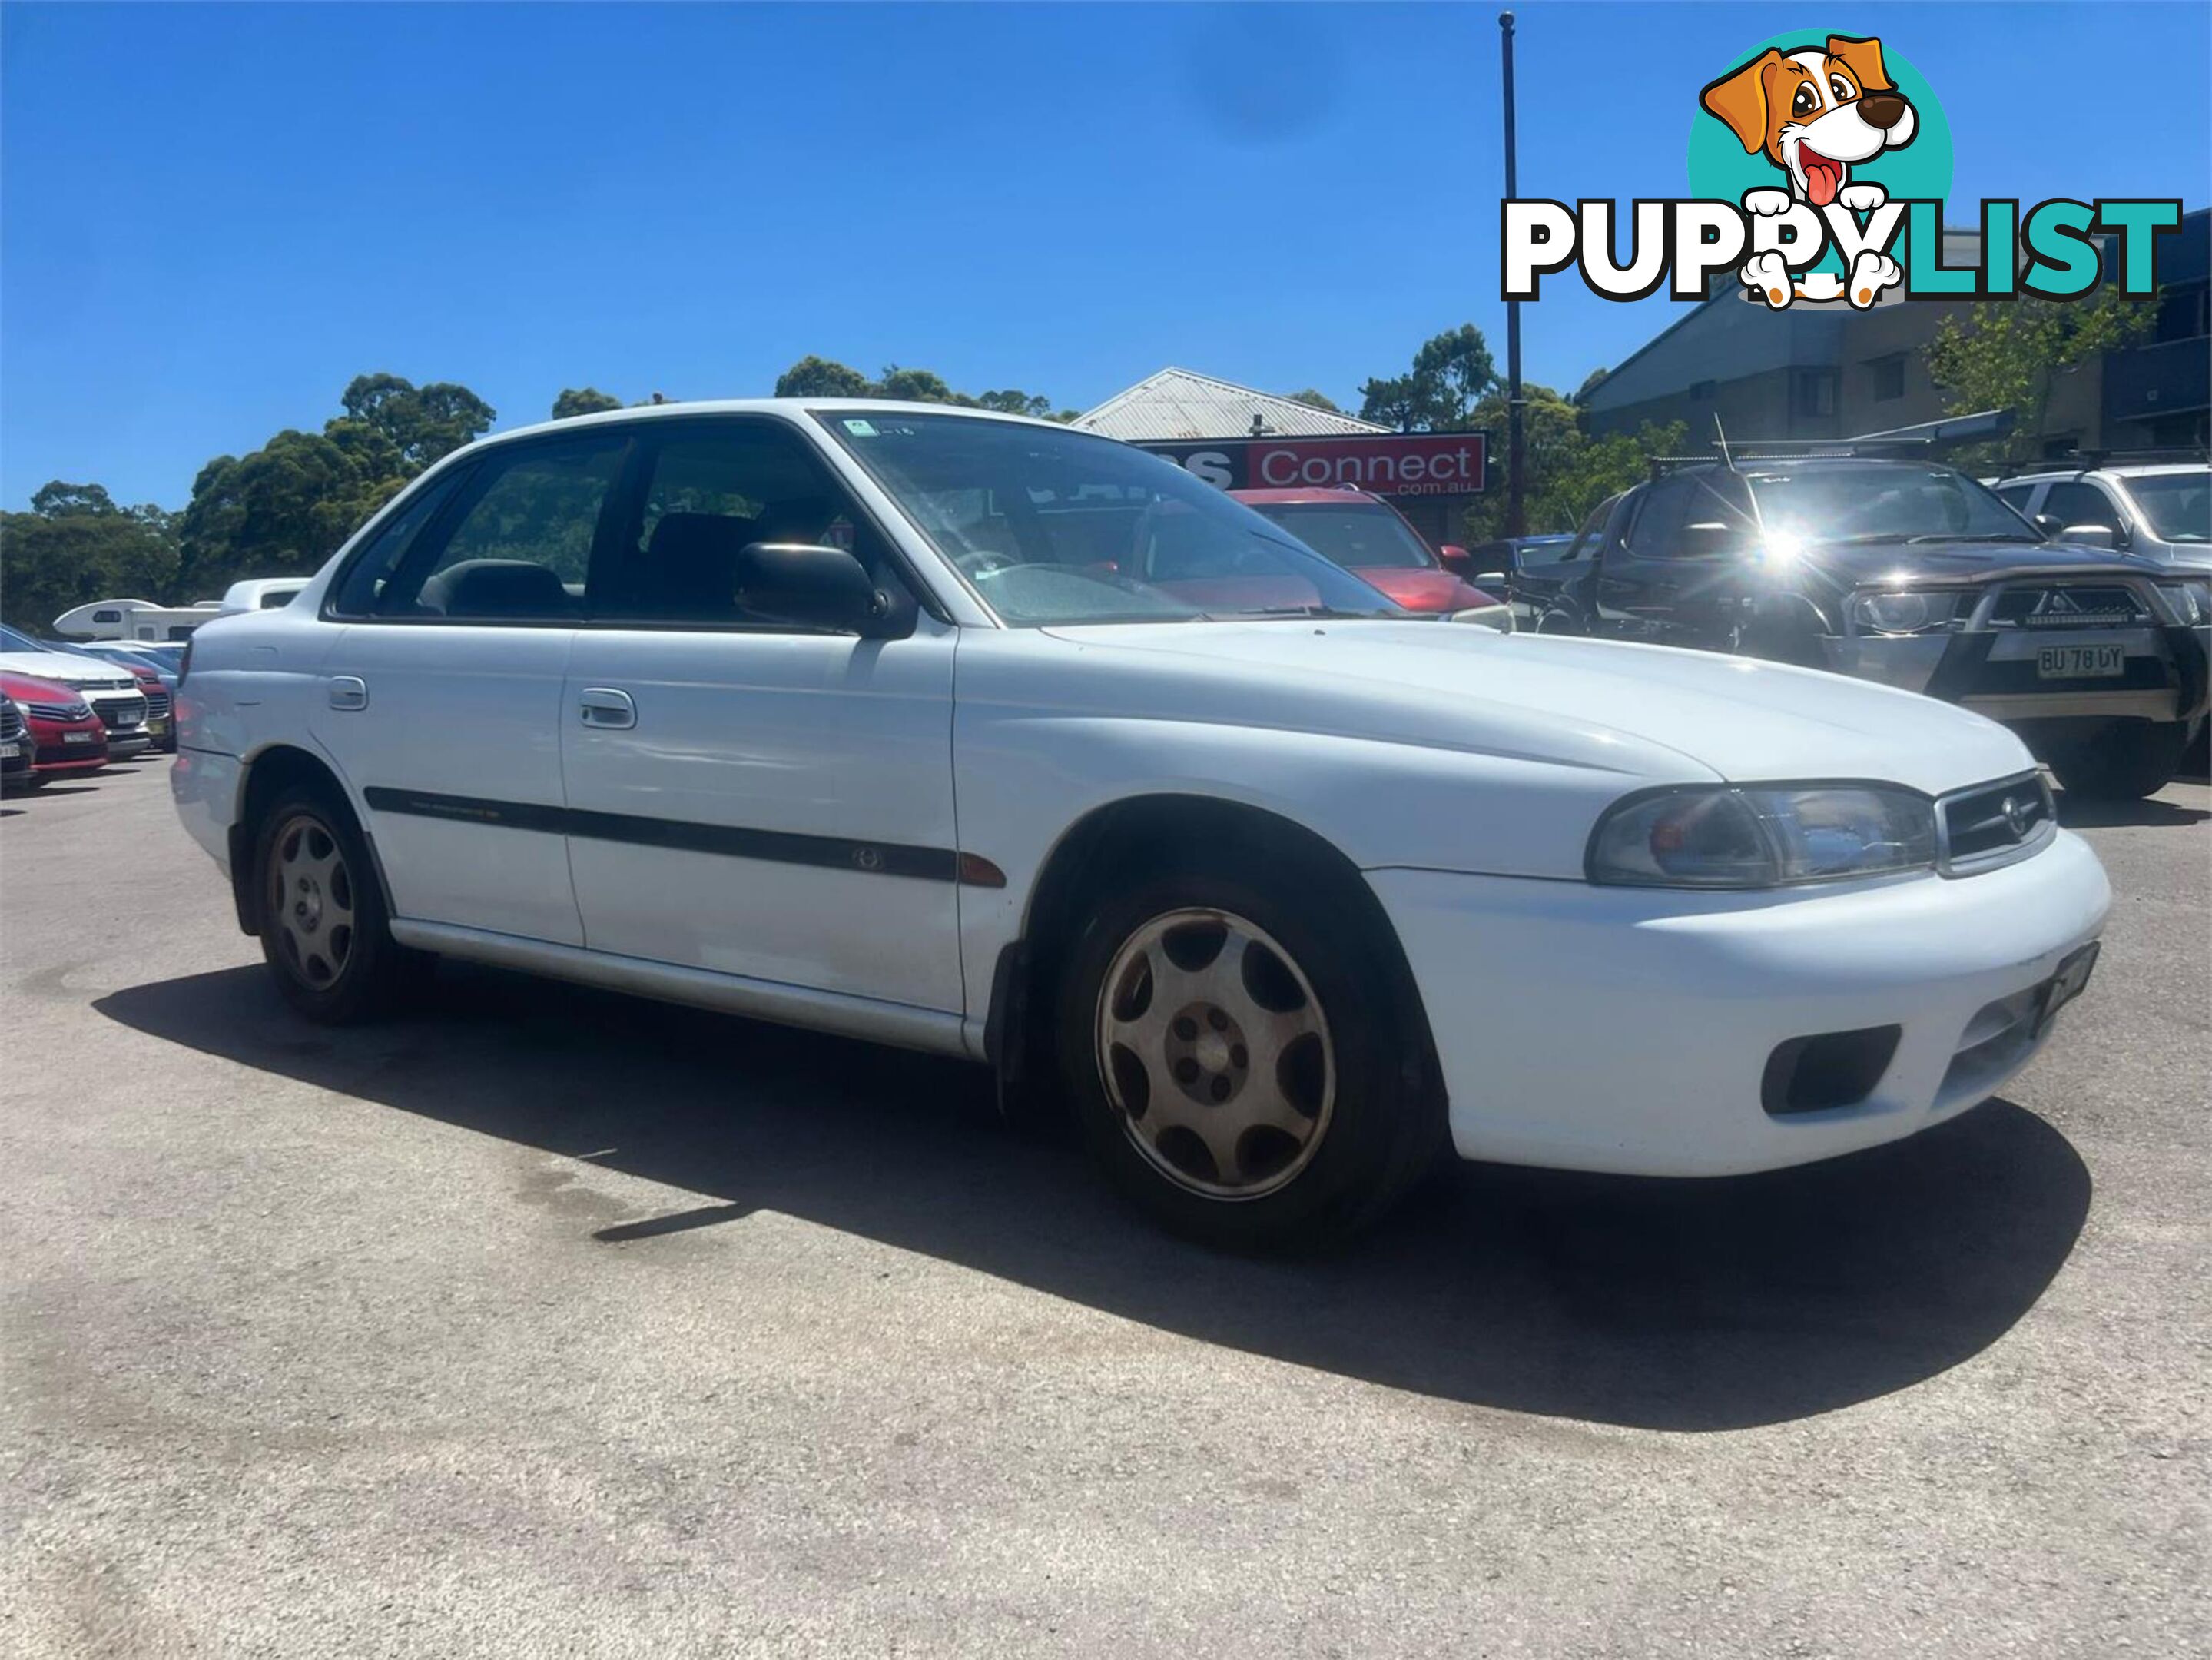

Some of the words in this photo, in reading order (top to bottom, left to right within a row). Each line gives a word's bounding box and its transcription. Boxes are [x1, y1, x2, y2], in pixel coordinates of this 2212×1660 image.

[1261, 447, 1471, 486] Connect
[1398, 481, 1471, 496] com.au
[2042, 650, 2066, 671] BU
[2071, 649, 2094, 669] 78
